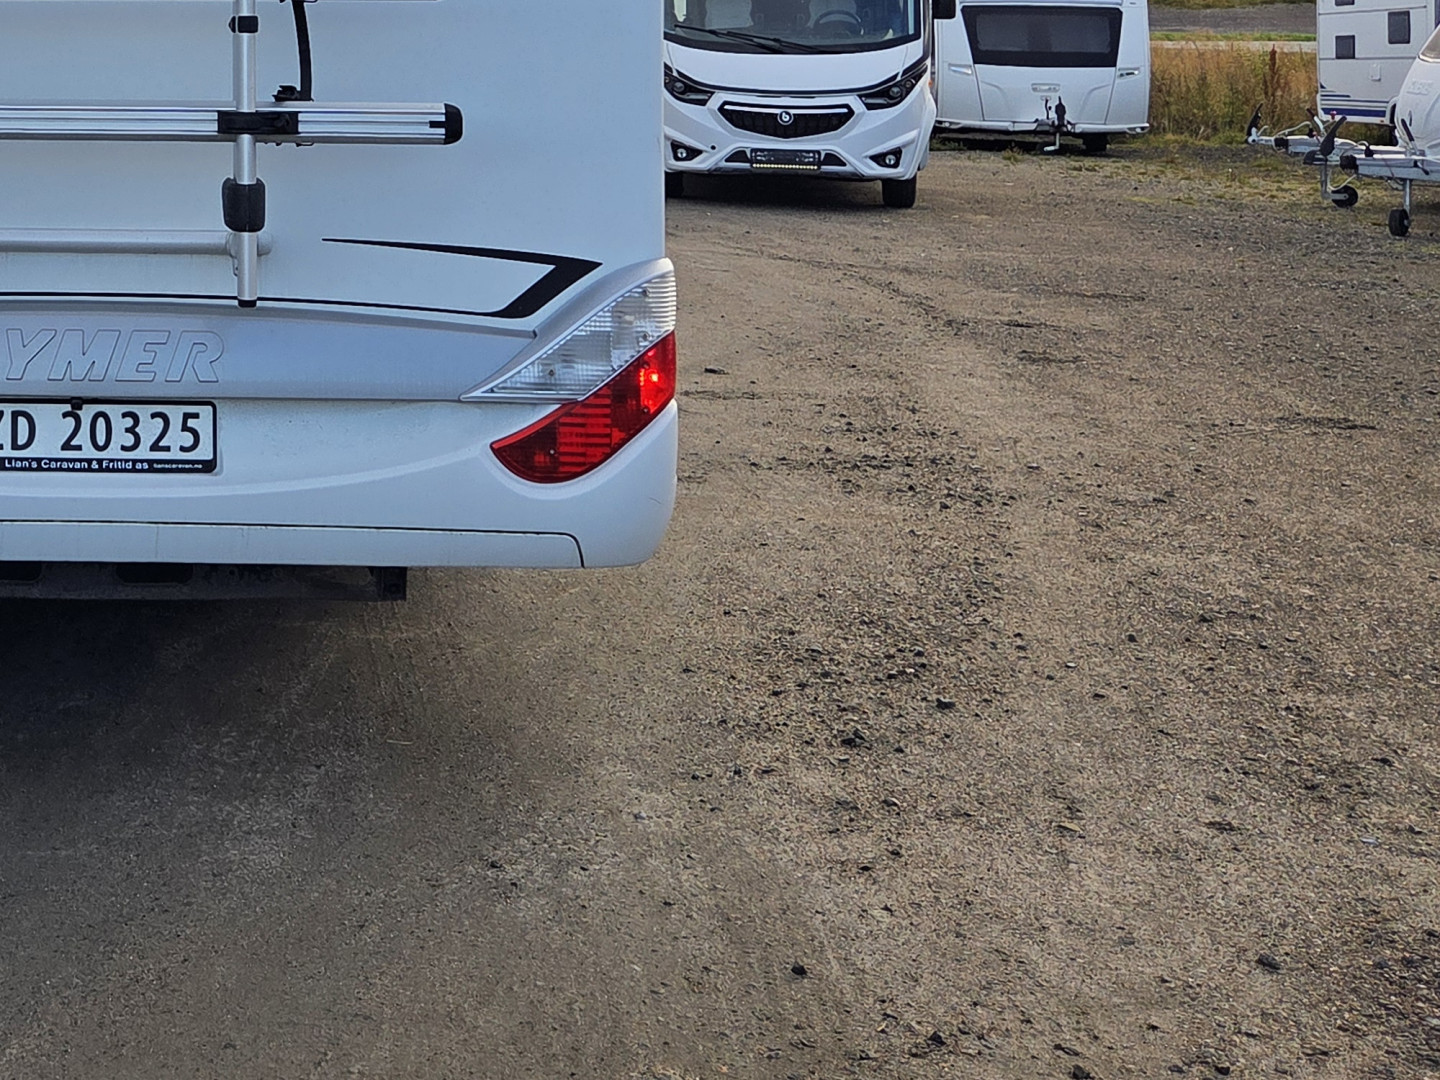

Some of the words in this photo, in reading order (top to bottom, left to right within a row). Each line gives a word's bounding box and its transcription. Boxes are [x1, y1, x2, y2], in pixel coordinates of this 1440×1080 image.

[60, 410, 201, 453] 20325
[5, 458, 38, 468] Lian's
[41, 459, 88, 469] Caravan
[91, 460, 99, 469] &
[102, 460, 132, 469] Fritid
